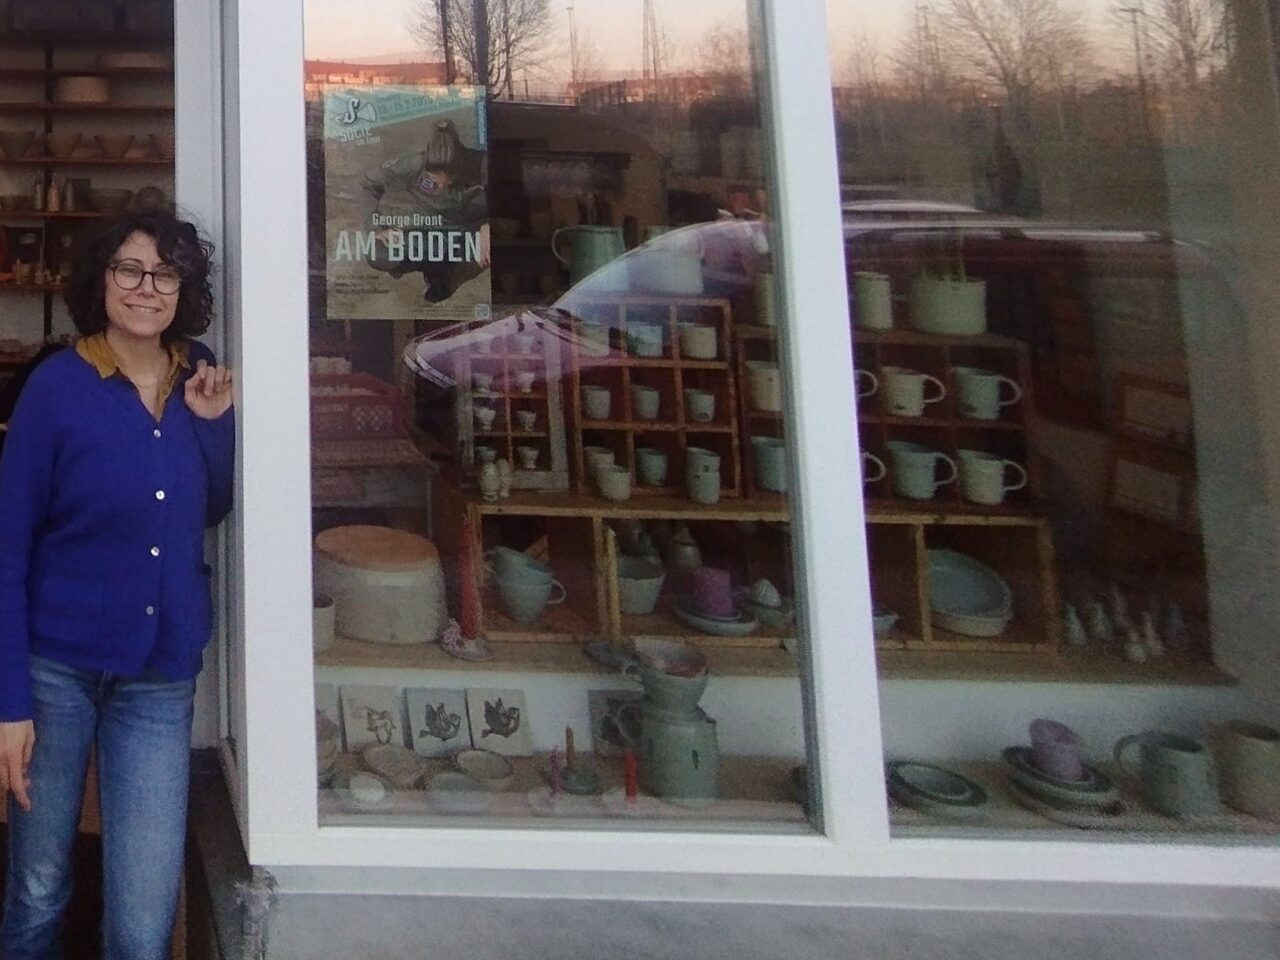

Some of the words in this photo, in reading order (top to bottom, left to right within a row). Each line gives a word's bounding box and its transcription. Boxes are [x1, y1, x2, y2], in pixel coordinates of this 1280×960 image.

[372, 213, 410, 227] George
[335, 230, 376, 261] AM
[388, 230, 481, 262] BODEN
